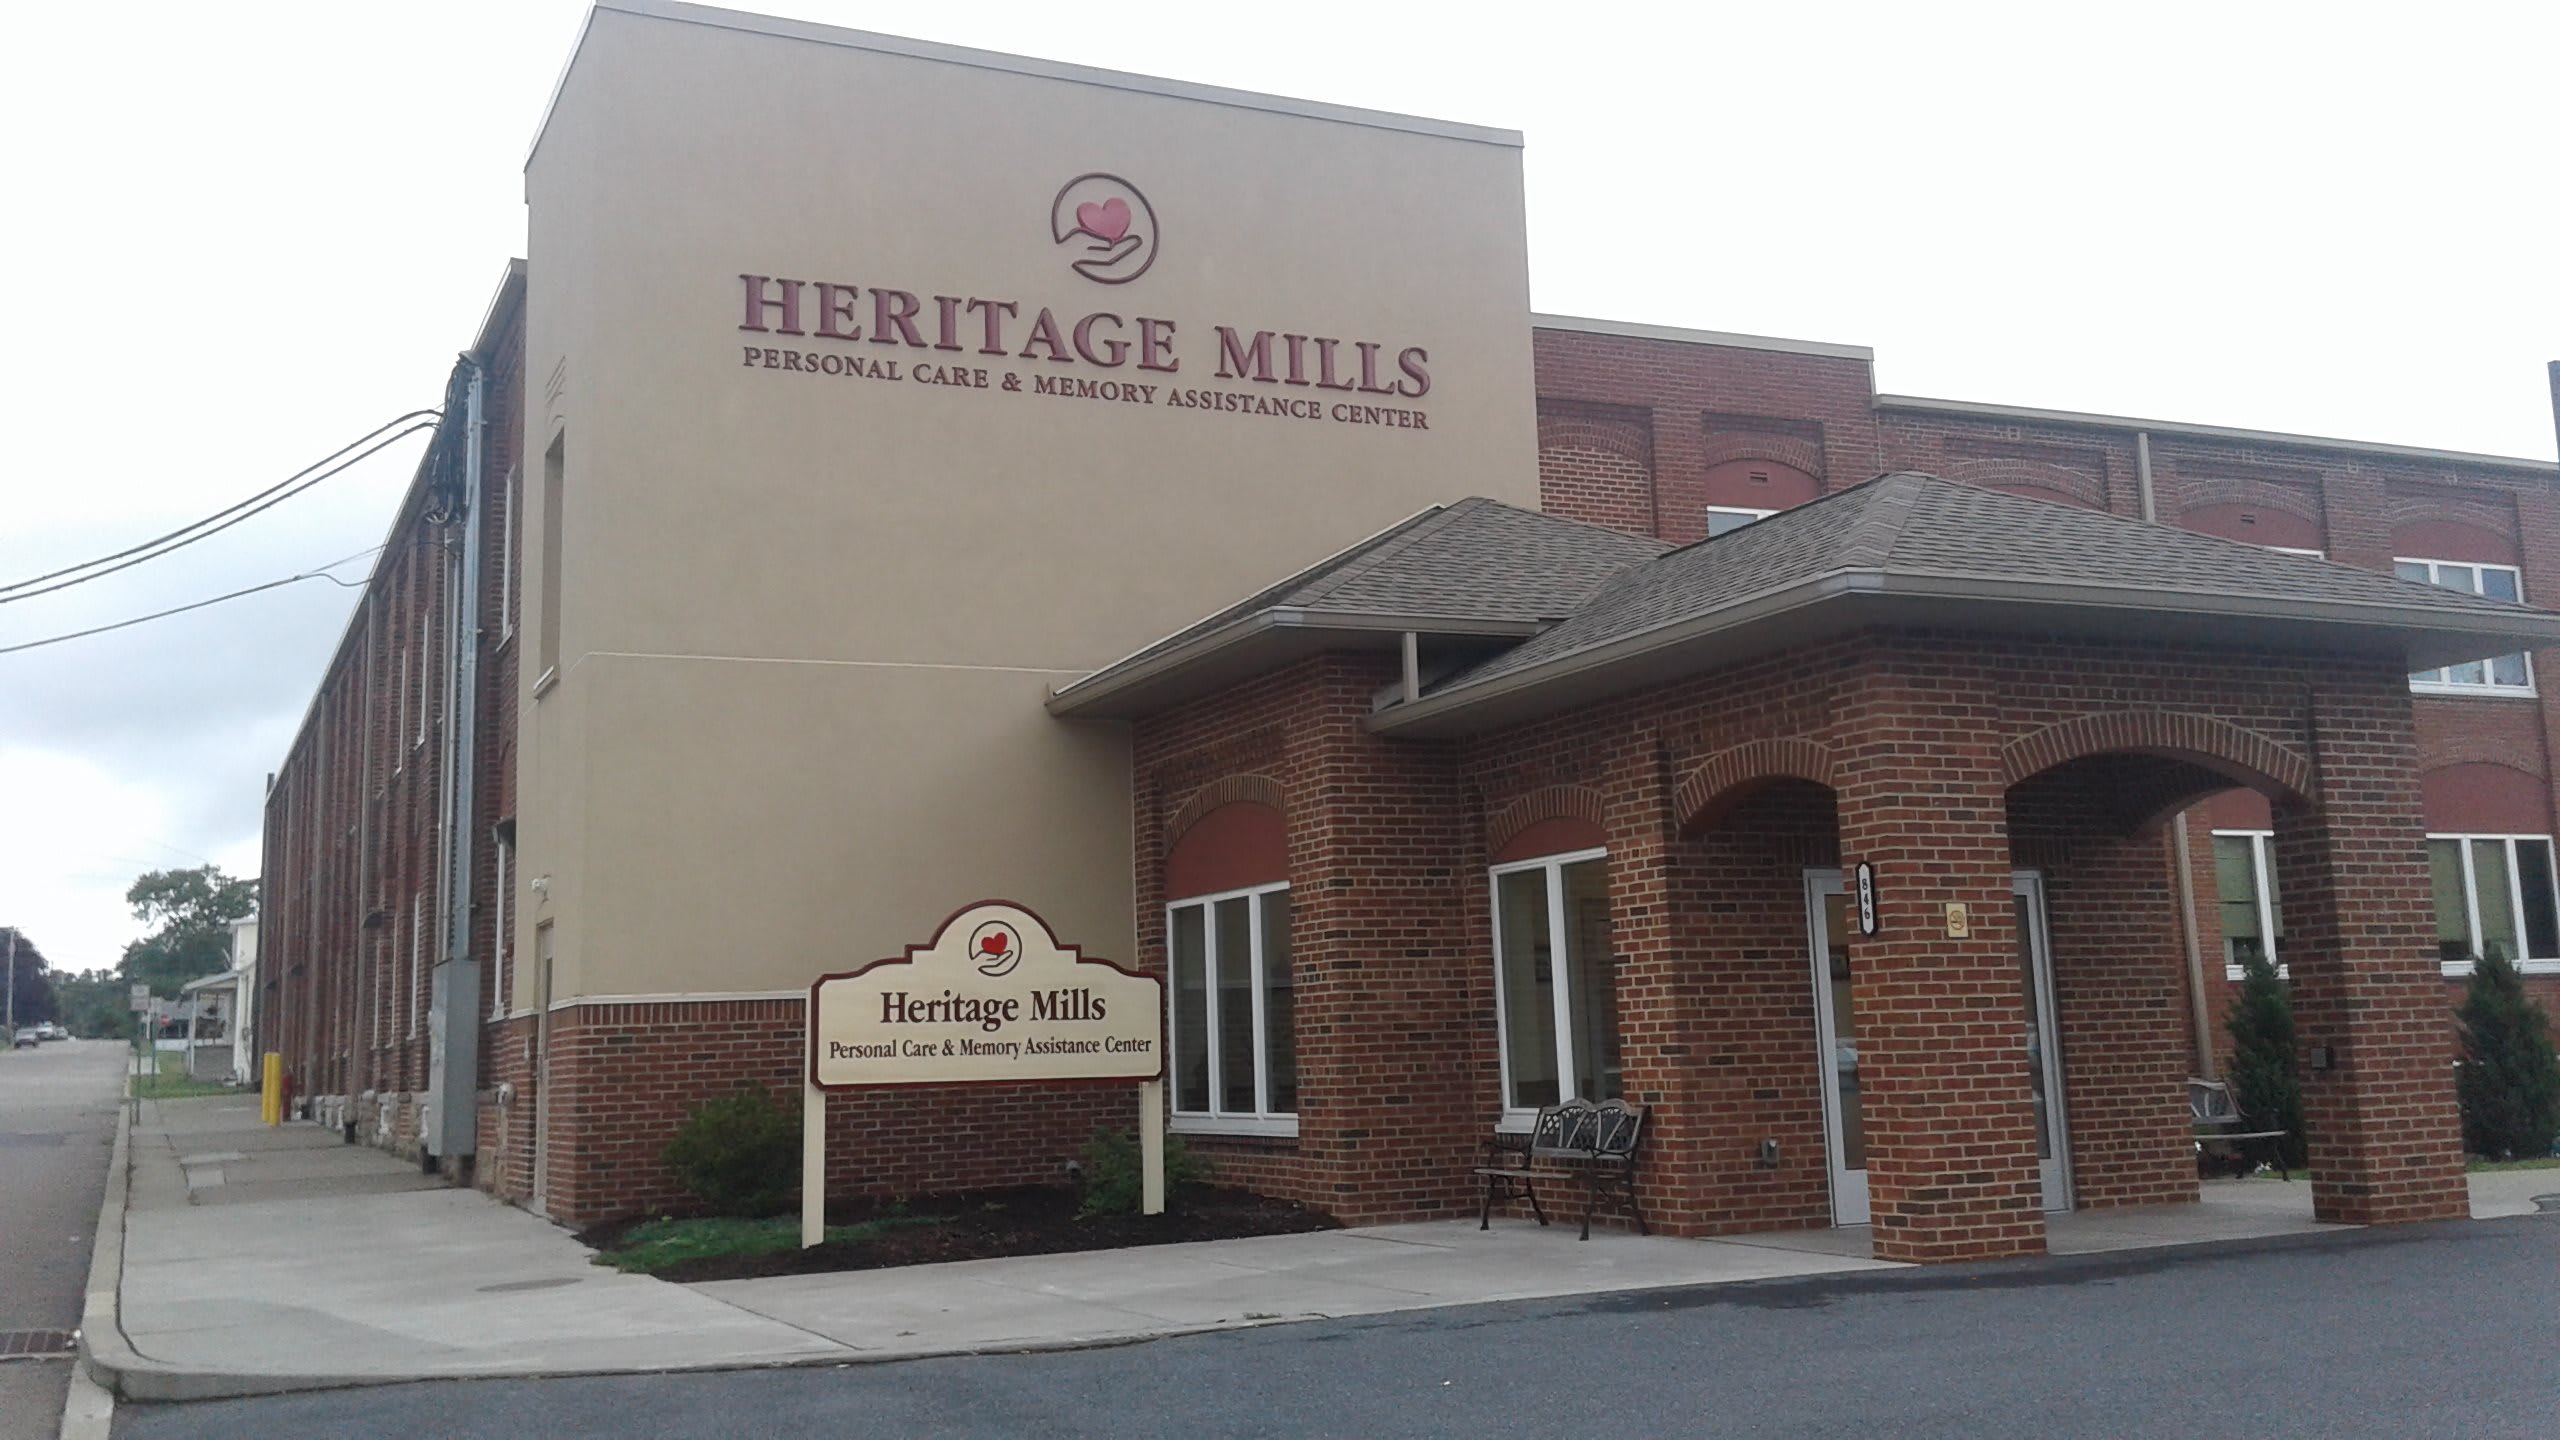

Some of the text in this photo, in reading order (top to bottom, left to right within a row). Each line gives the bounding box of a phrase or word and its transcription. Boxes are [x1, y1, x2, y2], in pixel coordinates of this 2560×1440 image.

[738, 274, 1431, 398] HERITAGE MILLS
[743, 345, 1429, 430] PERSONAL CARE & MEMORY ASSISTANCE CENTER
[1861, 878, 1870, 920] 846
[880, 987, 1106, 1032] Heritage Mills
[829, 1035, 1152, 1060] Personal Care & Memory Assistance Center
